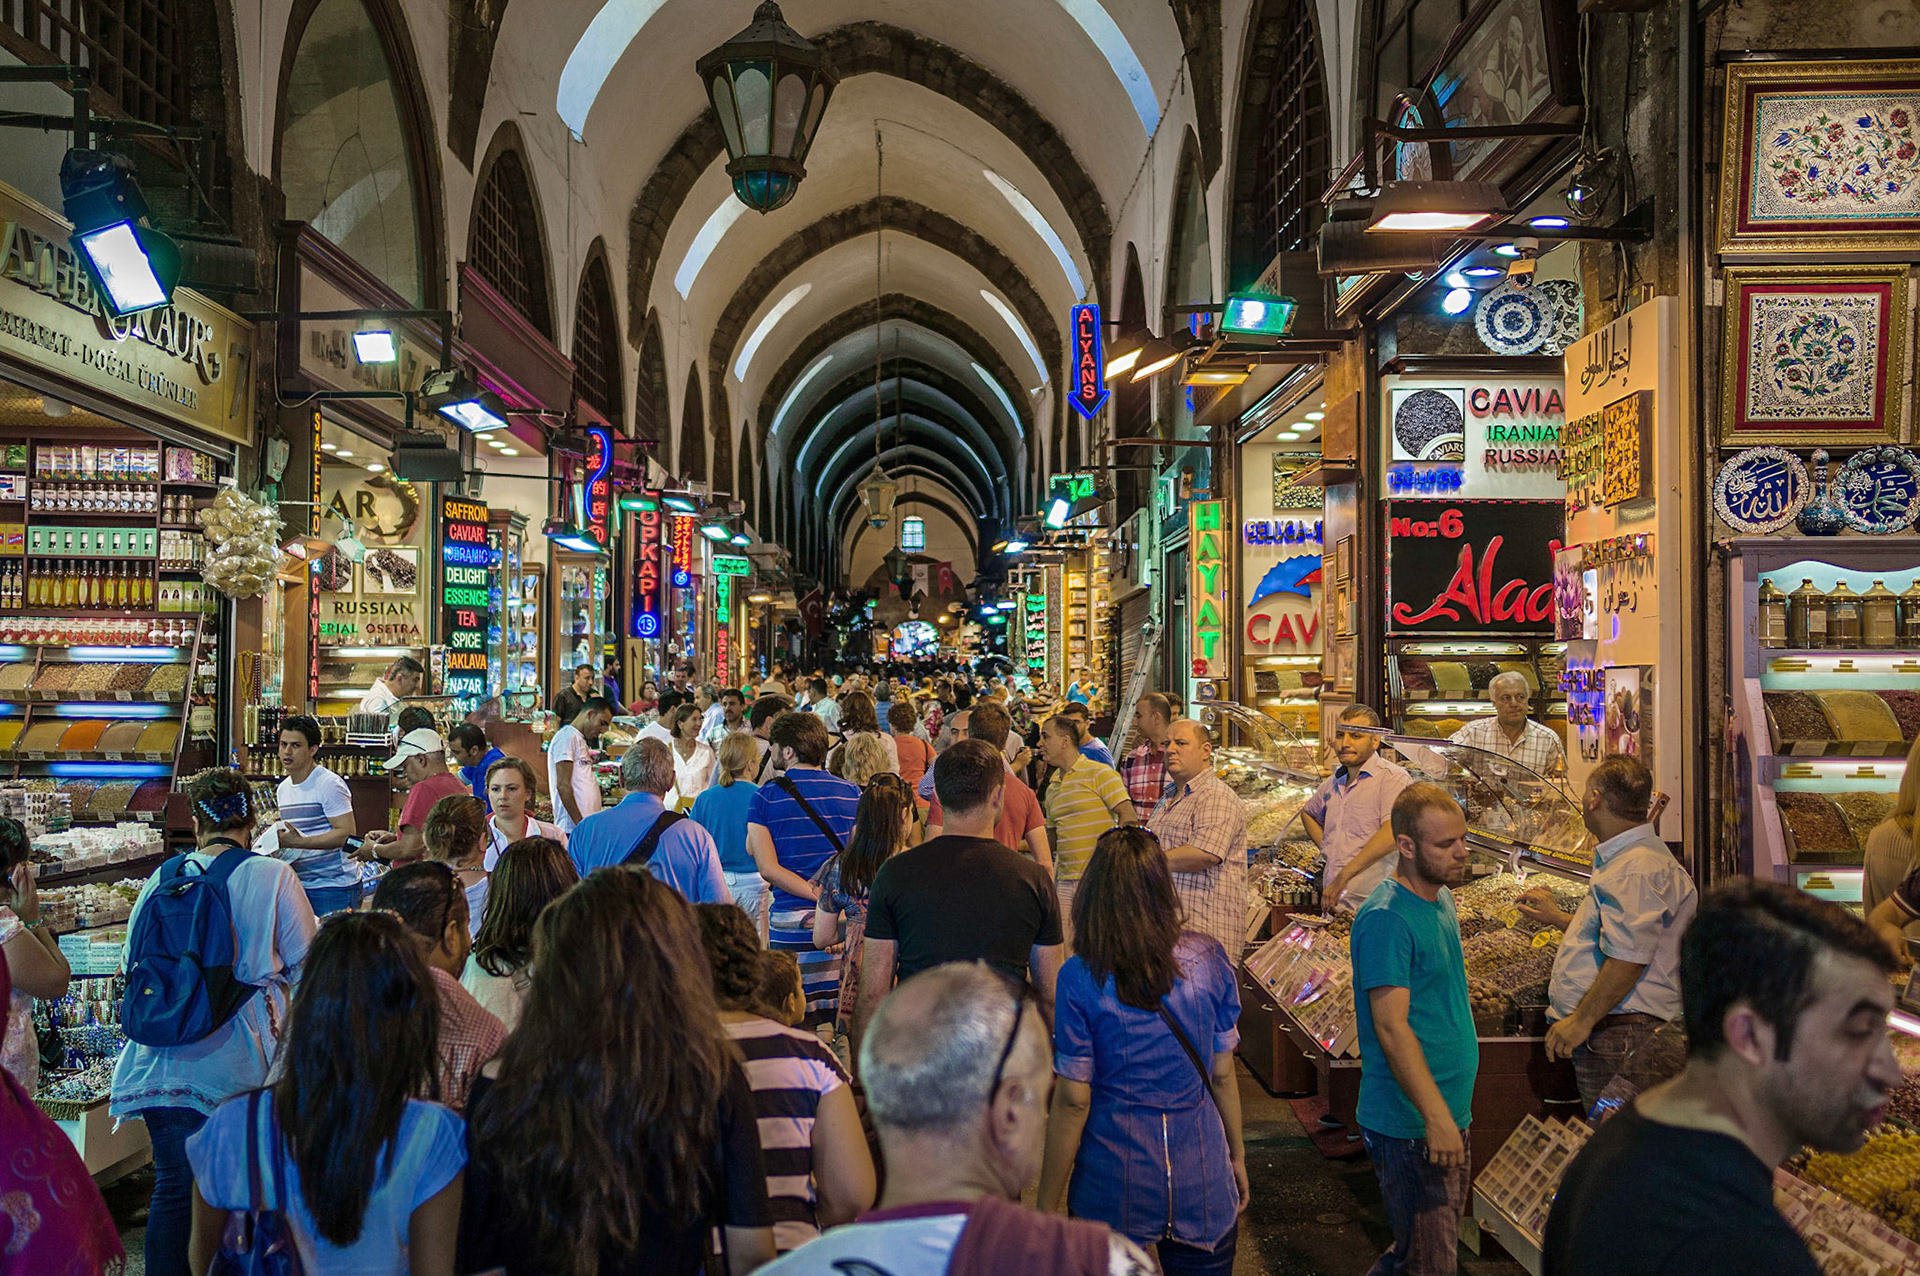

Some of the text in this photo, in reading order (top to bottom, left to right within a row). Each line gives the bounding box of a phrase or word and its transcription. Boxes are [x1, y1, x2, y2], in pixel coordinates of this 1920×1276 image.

[1080, 308, 1096, 399] ALYANS
[81, 343, 135, 383] DOĞAL
[138, 364, 199, 410] ÜRÜNLER
[1471, 387, 1565, 413] CAVIA
[1487, 424, 1561, 440] IRANIA
[1391, 471, 1462, 485] BELUGA
[445, 501, 488, 522] SAFFRON
[449, 523, 484, 543] CAVIAR
[446, 545, 488, 564] CERAMIC
[446, 566, 488, 586] DELIGHT
[1195, 503, 1222, 658] HAYAT
[444, 587, 488, 607] ESSENCE
[334, 601, 414, 616] RUSSIAN
[365, 622, 420, 634] OSETRA
[456, 610, 477, 627] TEA
[641, 618, 654, 631] 13
[311, 576, 320, 698] CAVIAR
[1247, 612, 1320, 645] CAV
[452, 631, 482, 648] SPICE
[446, 653, 488, 670] BAKLAVA
[449, 677, 482, 695] NAZAR
